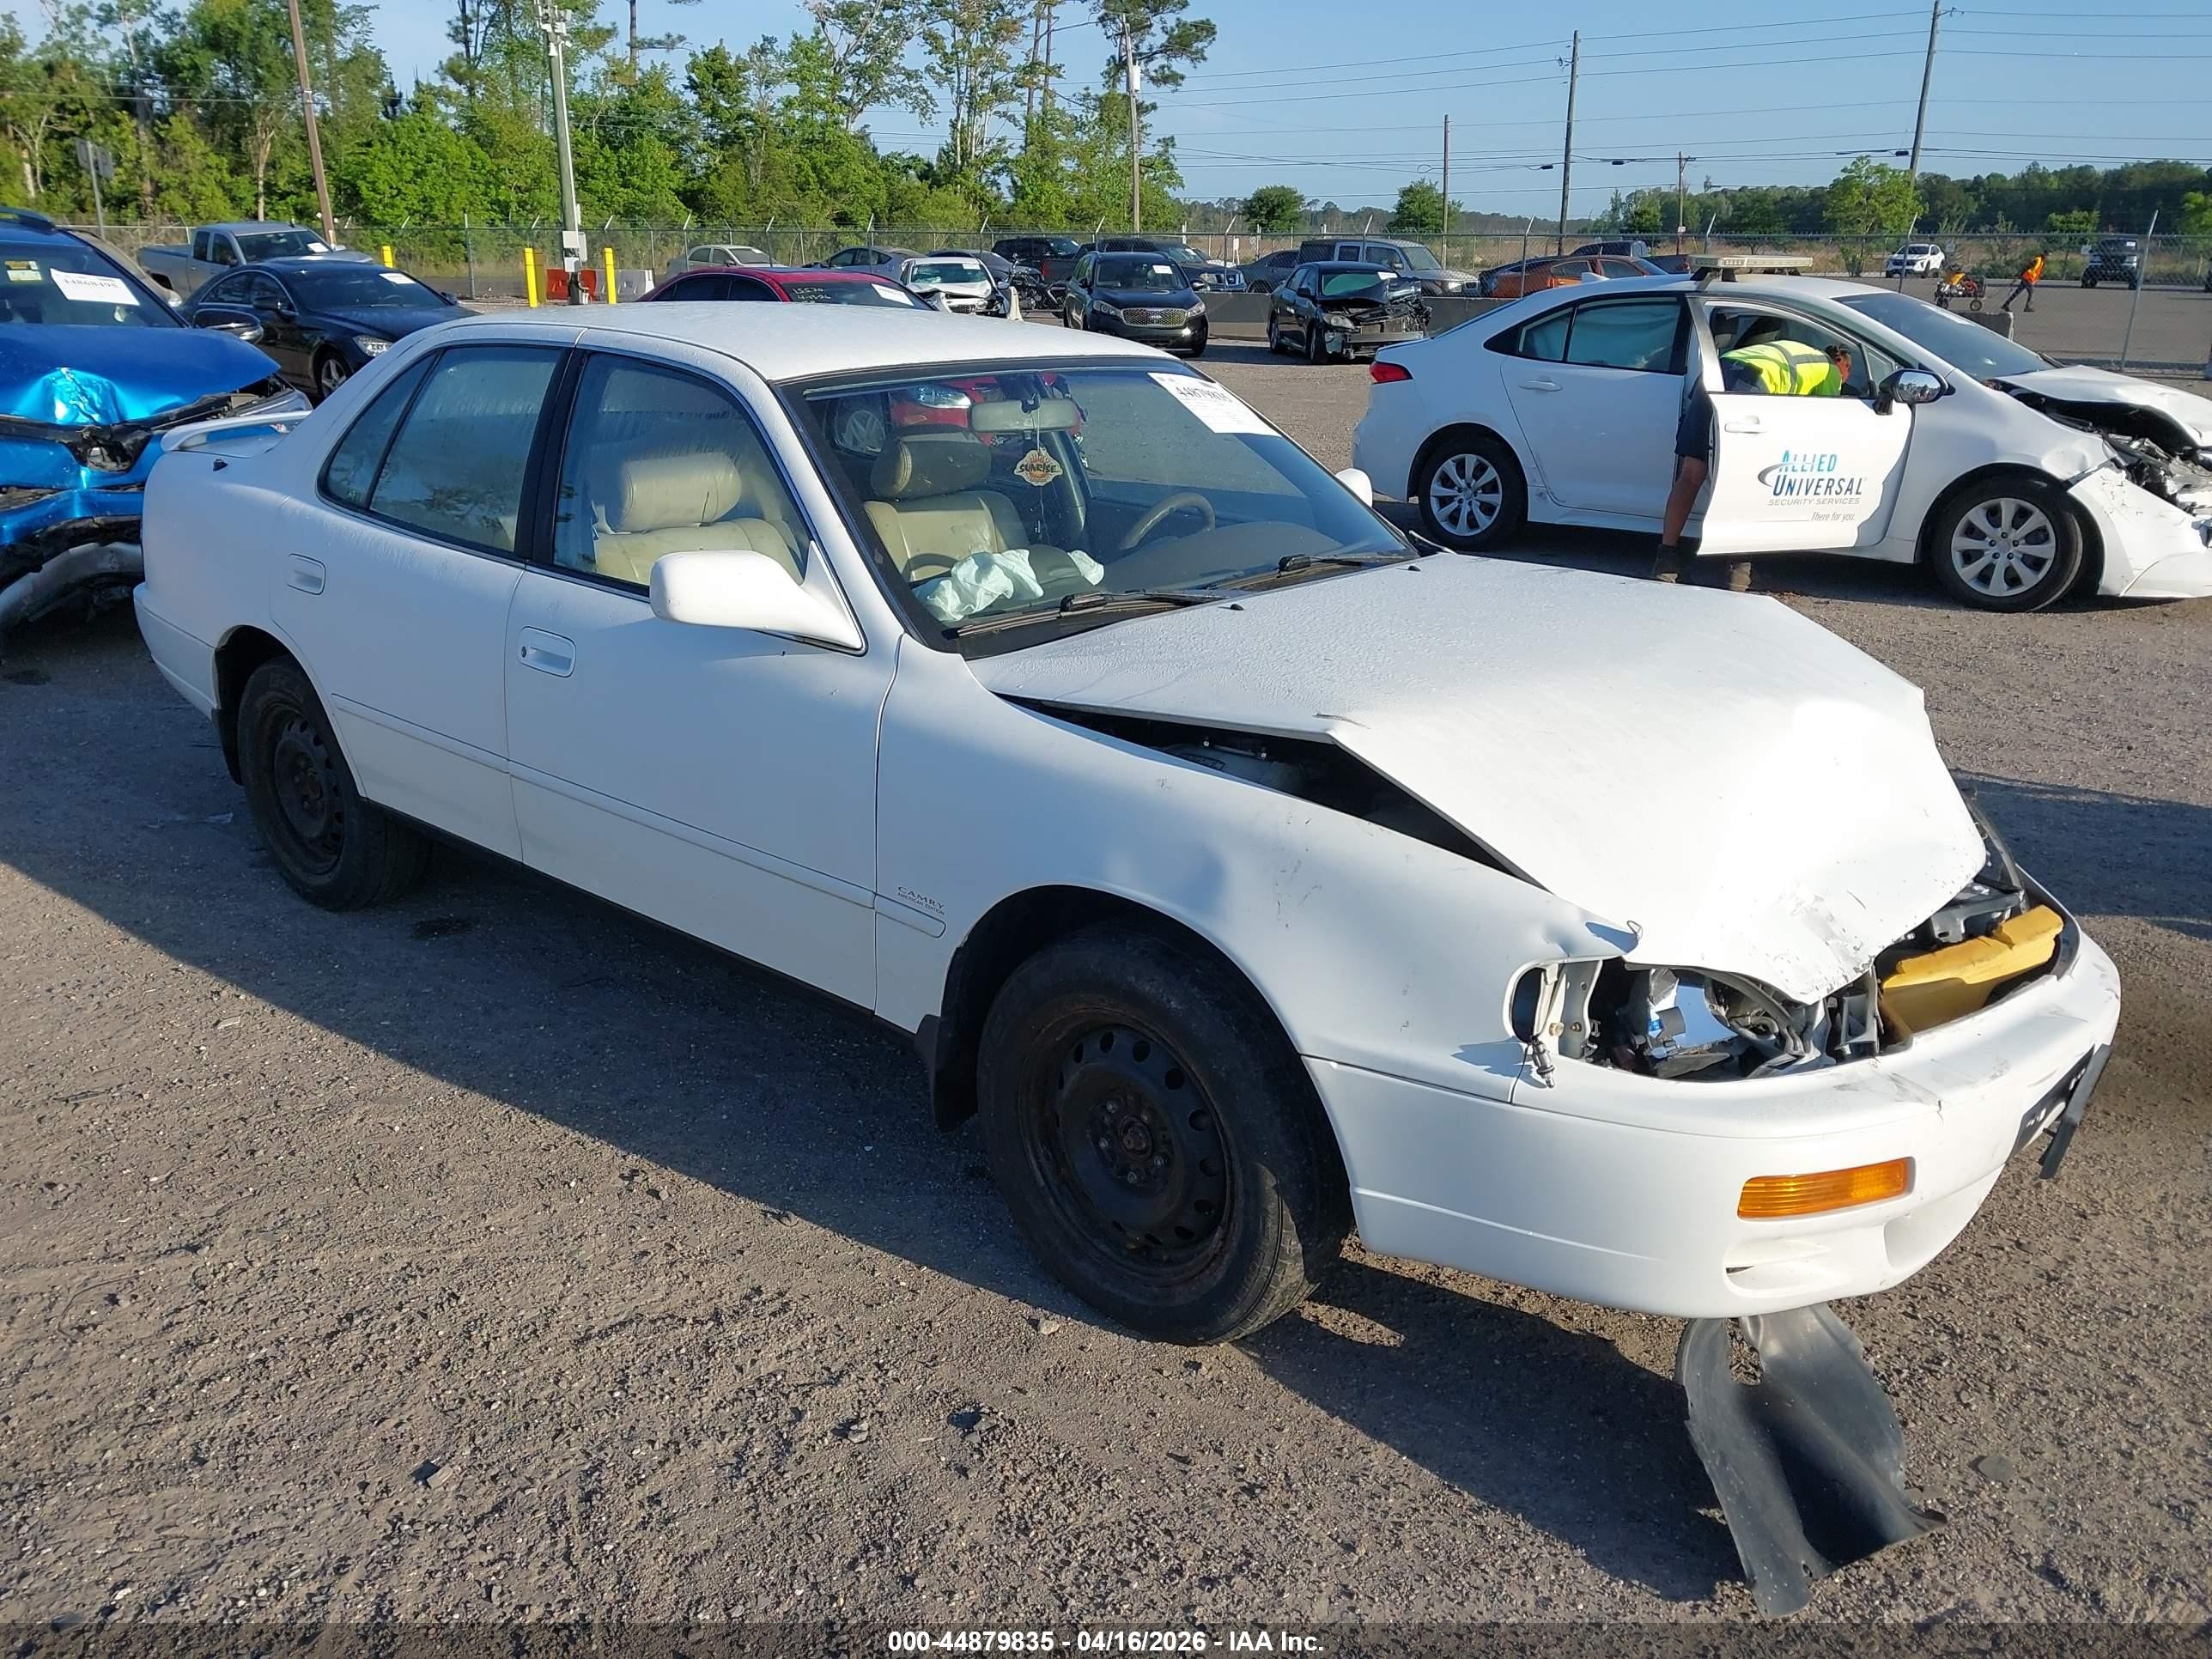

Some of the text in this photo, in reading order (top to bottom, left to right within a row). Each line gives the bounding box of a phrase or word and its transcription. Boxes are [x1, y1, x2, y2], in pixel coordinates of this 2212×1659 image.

[1018, 462, 1060, 473] SUNRISE
[1778, 449, 1838, 472] ALLIED
[1772, 474, 1863, 496] UNIVERSAL
[1767, 497, 1814, 507] SECURITY
[1831, 511, 1841, 522] for
[897, 885, 945, 909] CAMRY
